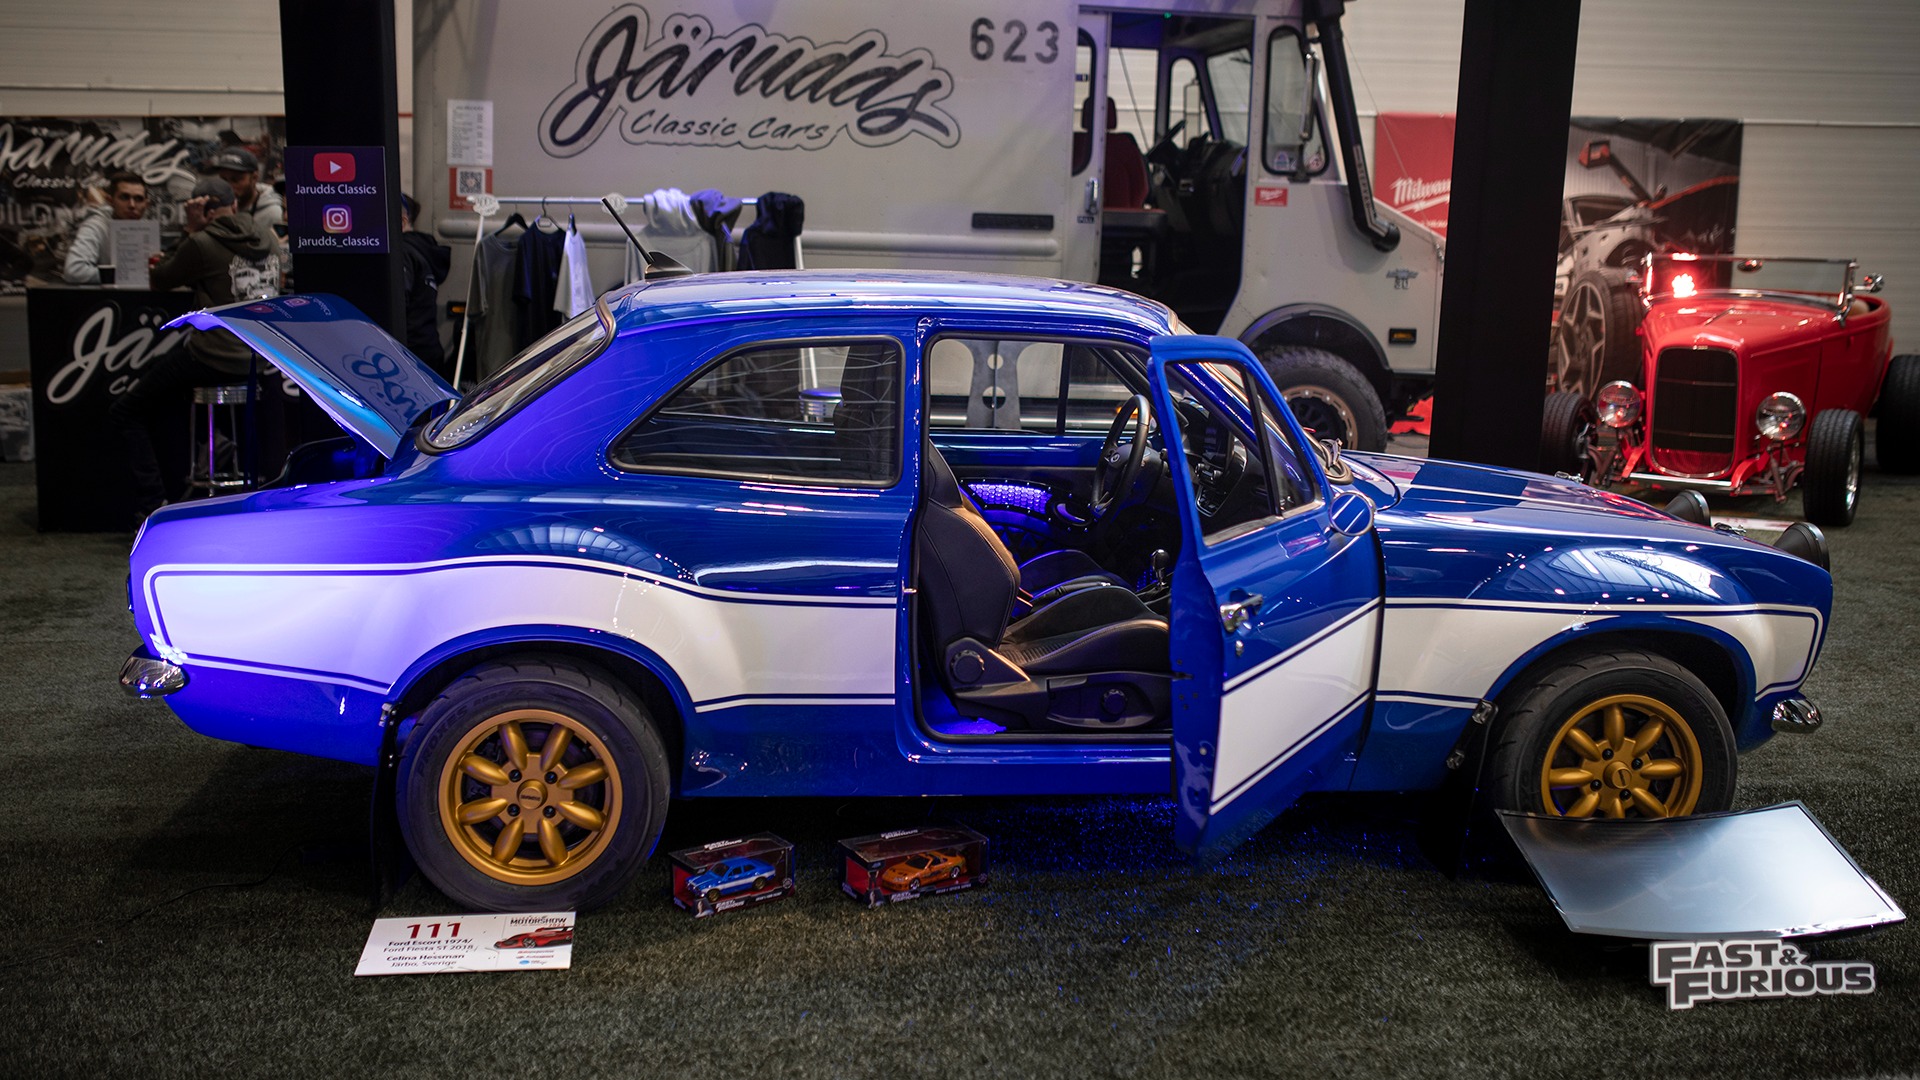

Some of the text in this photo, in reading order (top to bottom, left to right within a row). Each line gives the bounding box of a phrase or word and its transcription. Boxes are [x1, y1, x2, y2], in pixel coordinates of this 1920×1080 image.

[970, 17, 1059, 64] 623
[550, 15, 950, 146] Järudds
[629, 109, 830, 141] Classic Cars
[295, 184, 377, 195] Jarudds Classics
[406, 922, 461, 939] 111
[1672, 965, 1874, 1007] FURIOUS
